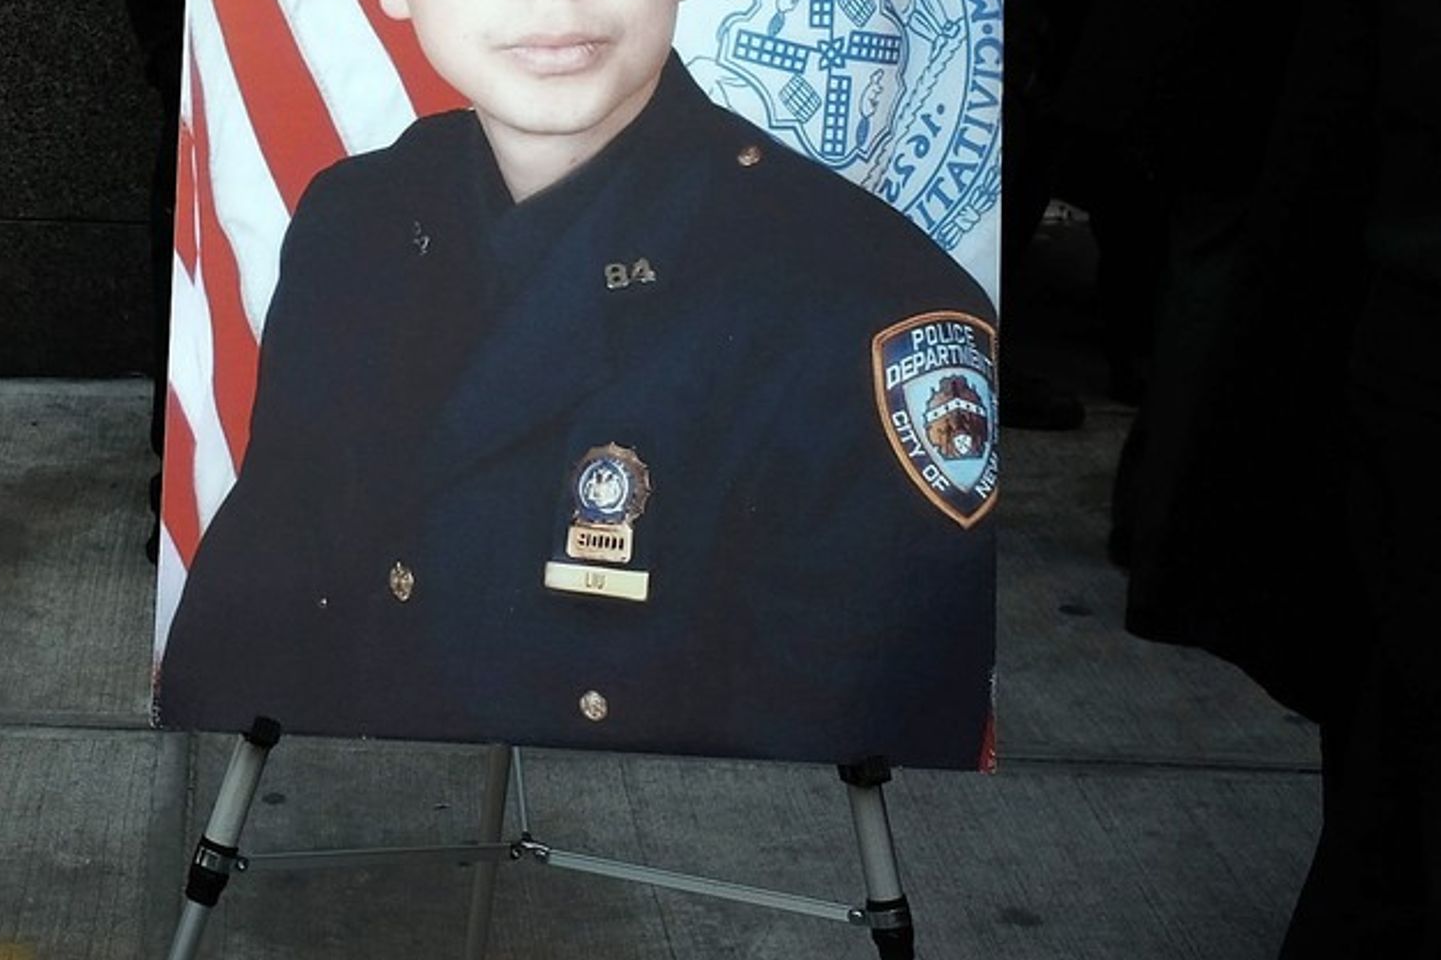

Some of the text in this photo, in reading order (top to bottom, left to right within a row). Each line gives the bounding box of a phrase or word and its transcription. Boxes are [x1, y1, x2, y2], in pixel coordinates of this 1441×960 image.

[604, 257, 656, 289] 84
[911, 322, 975, 351] POLICE
[886, 344, 993, 390] DEPARTMENT
[892, 410, 951, 493] CITY OF
